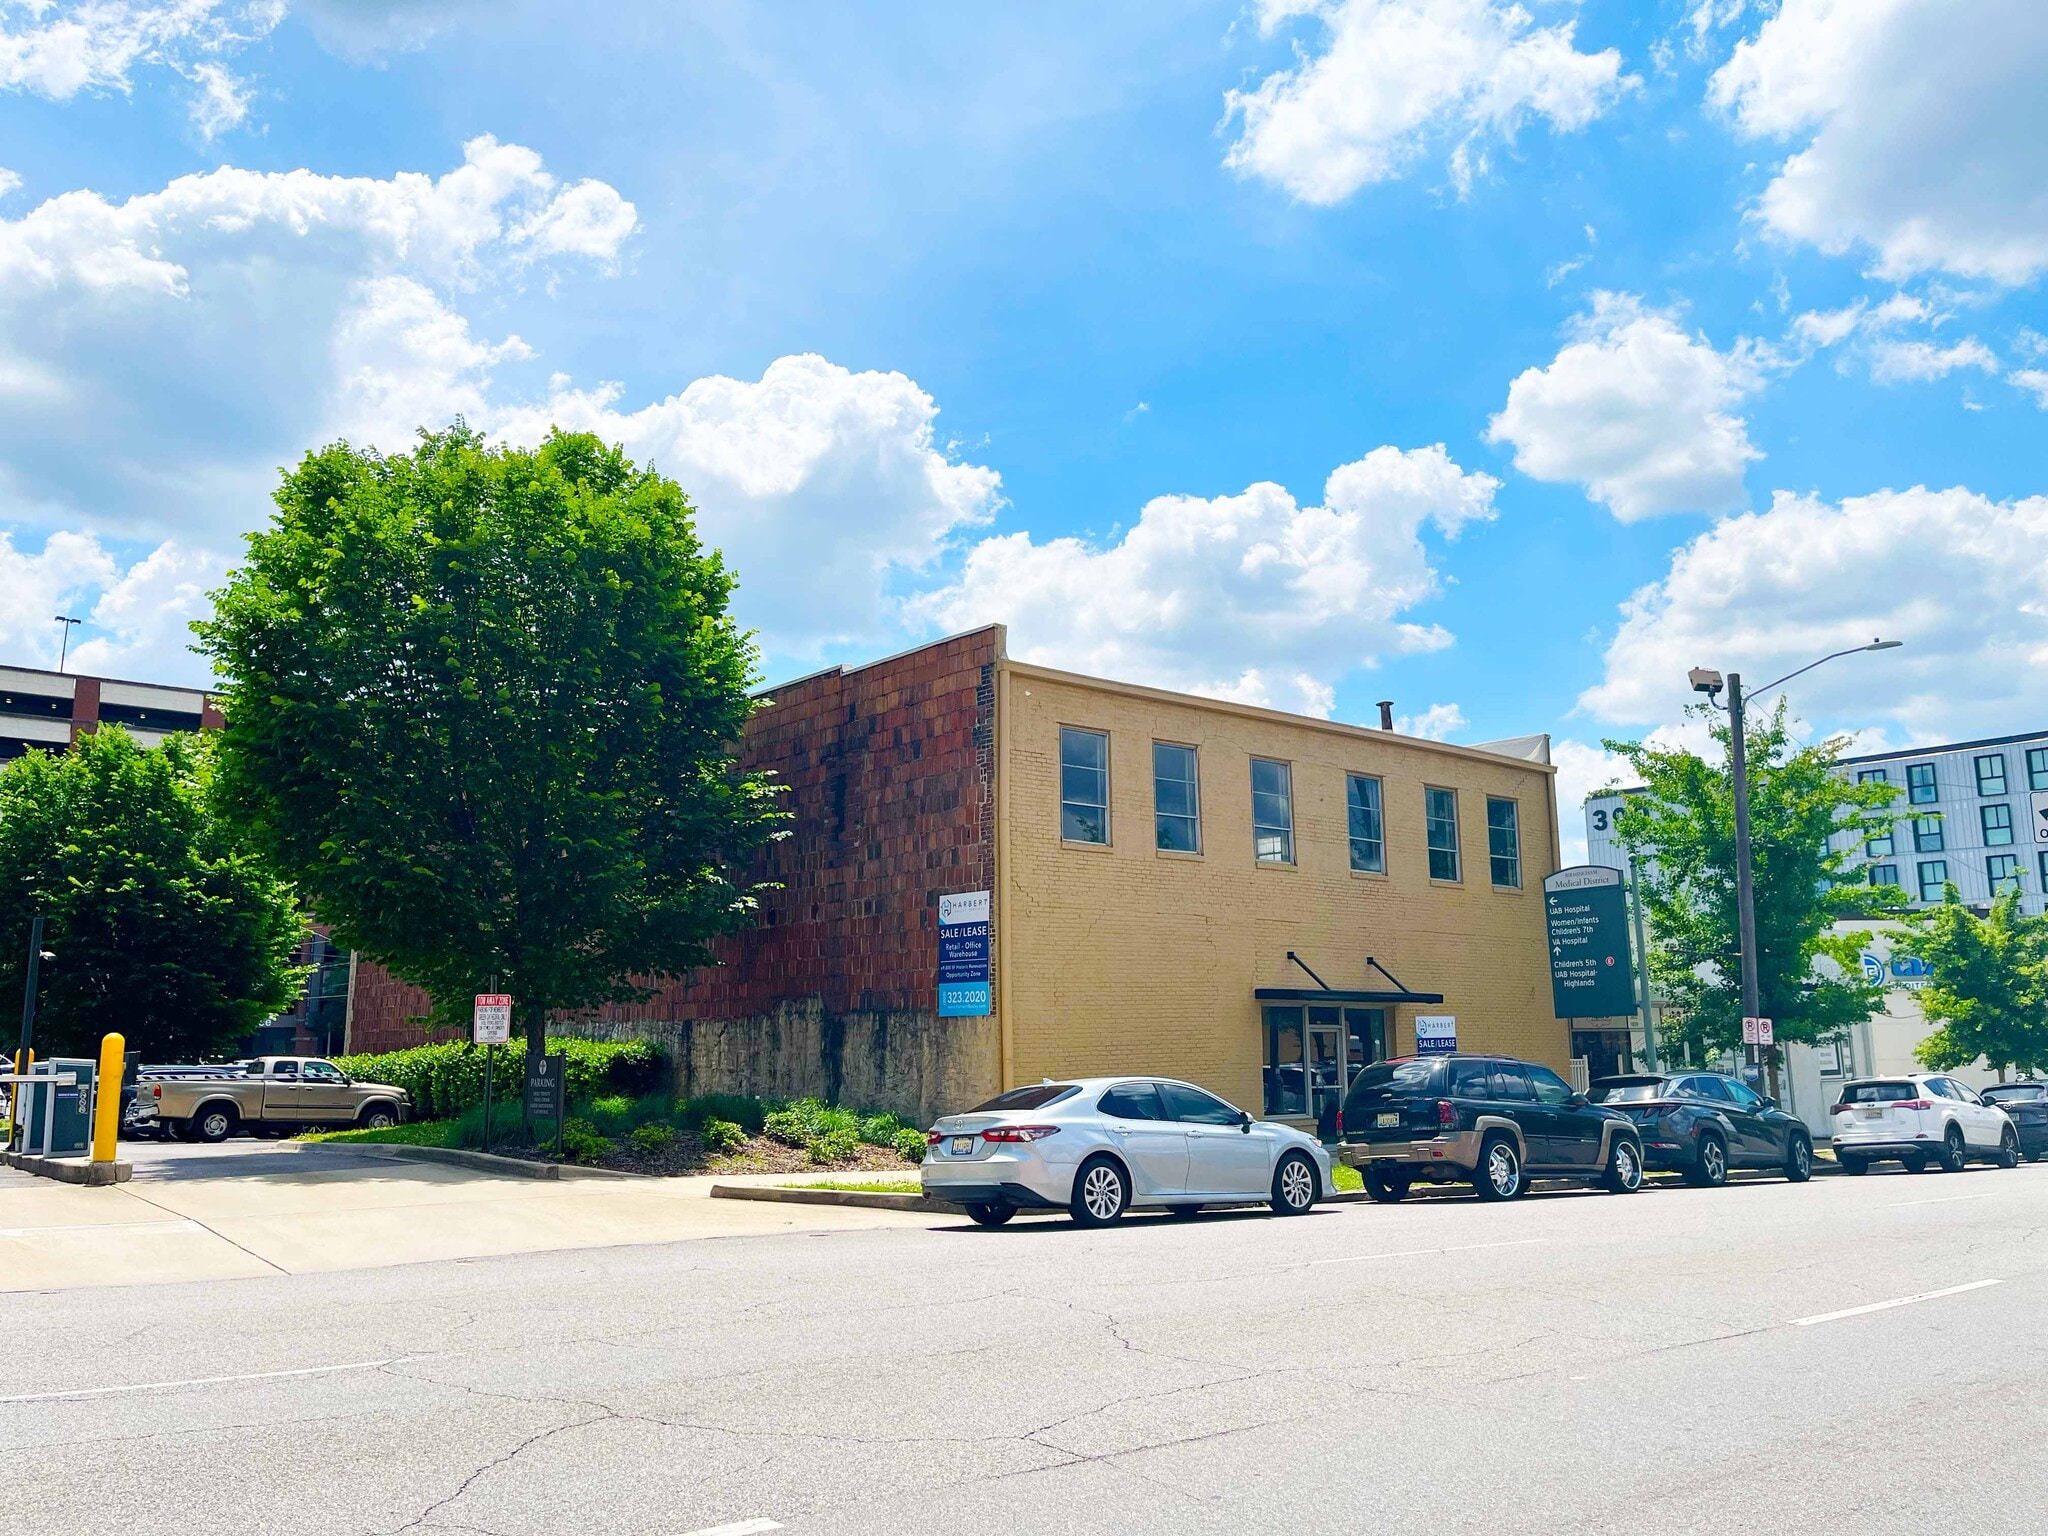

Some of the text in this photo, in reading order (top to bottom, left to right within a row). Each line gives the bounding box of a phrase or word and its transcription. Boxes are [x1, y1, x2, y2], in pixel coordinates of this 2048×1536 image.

[1555, 877, 1609, 888] Medical District
[953, 899, 988, 909] HARBERT
[1564, 904, 1590, 914] Hospital
[1551, 917, 1599, 927] Women/Infants
[941, 926, 987, 939] SALE/LEASE
[1551, 927, 1581, 936] Children's
[965, 941, 982, 949] Office
[1562, 937, 1588, 945] Hospital
[949, 950, 977, 958] Warehouse
[1554, 960, 1584, 968] Children's
[1564, 979, 1595, 988] Highlands
[947, 990, 986, 1003] 323.2020
[1428, 1020, 1454, 1029] HARBERT
[1419, 1039, 1456, 1048] SALE/LEASE
[530, 1078, 555, 1087] PARKING
